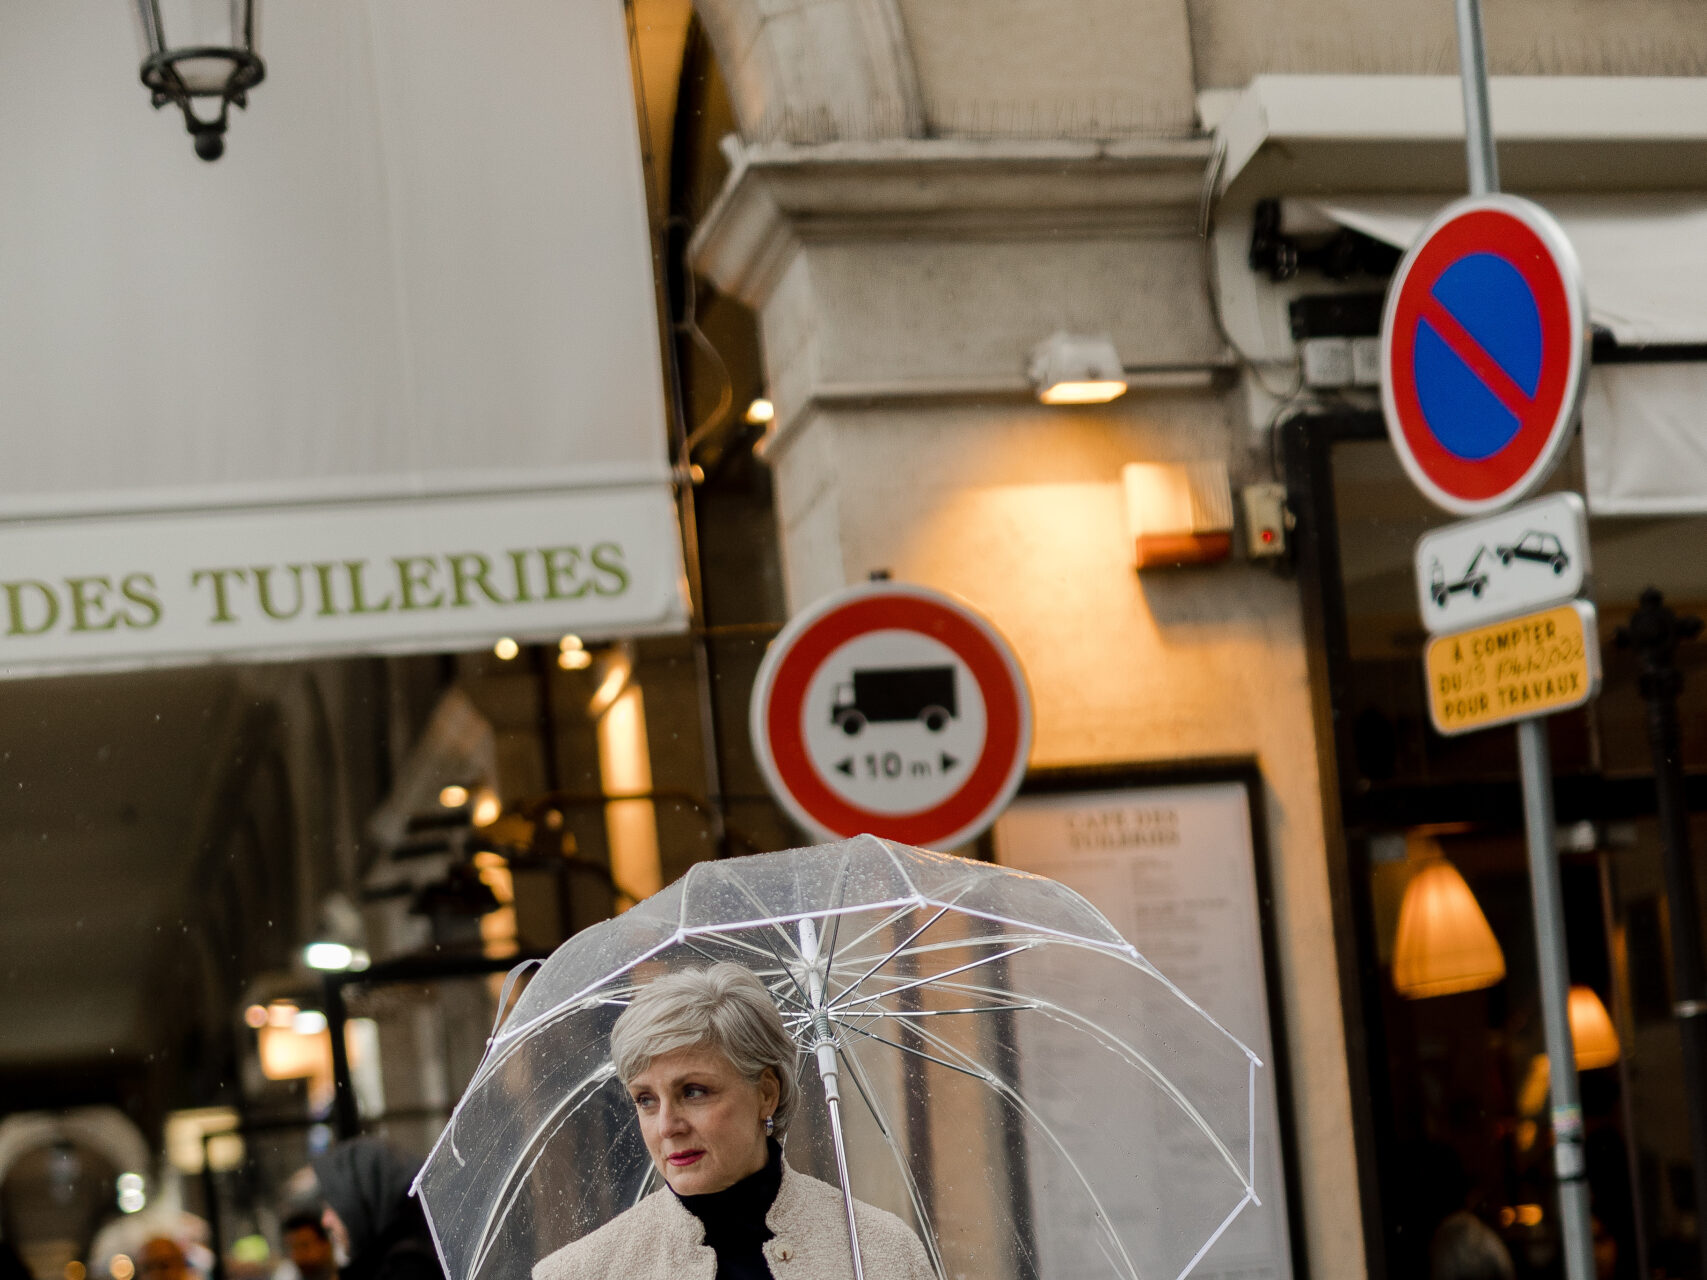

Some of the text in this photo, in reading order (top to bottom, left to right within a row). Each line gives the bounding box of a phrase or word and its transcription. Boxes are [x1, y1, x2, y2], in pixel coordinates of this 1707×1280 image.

[2, 542, 629, 636] DES TUILERIES
[1472, 619, 1557, 660] COMPTER
[1439, 671, 1462, 695] DU
[1444, 670, 1580, 720] POUR TRAVAUX
[865, 752, 932, 779] 10 m
